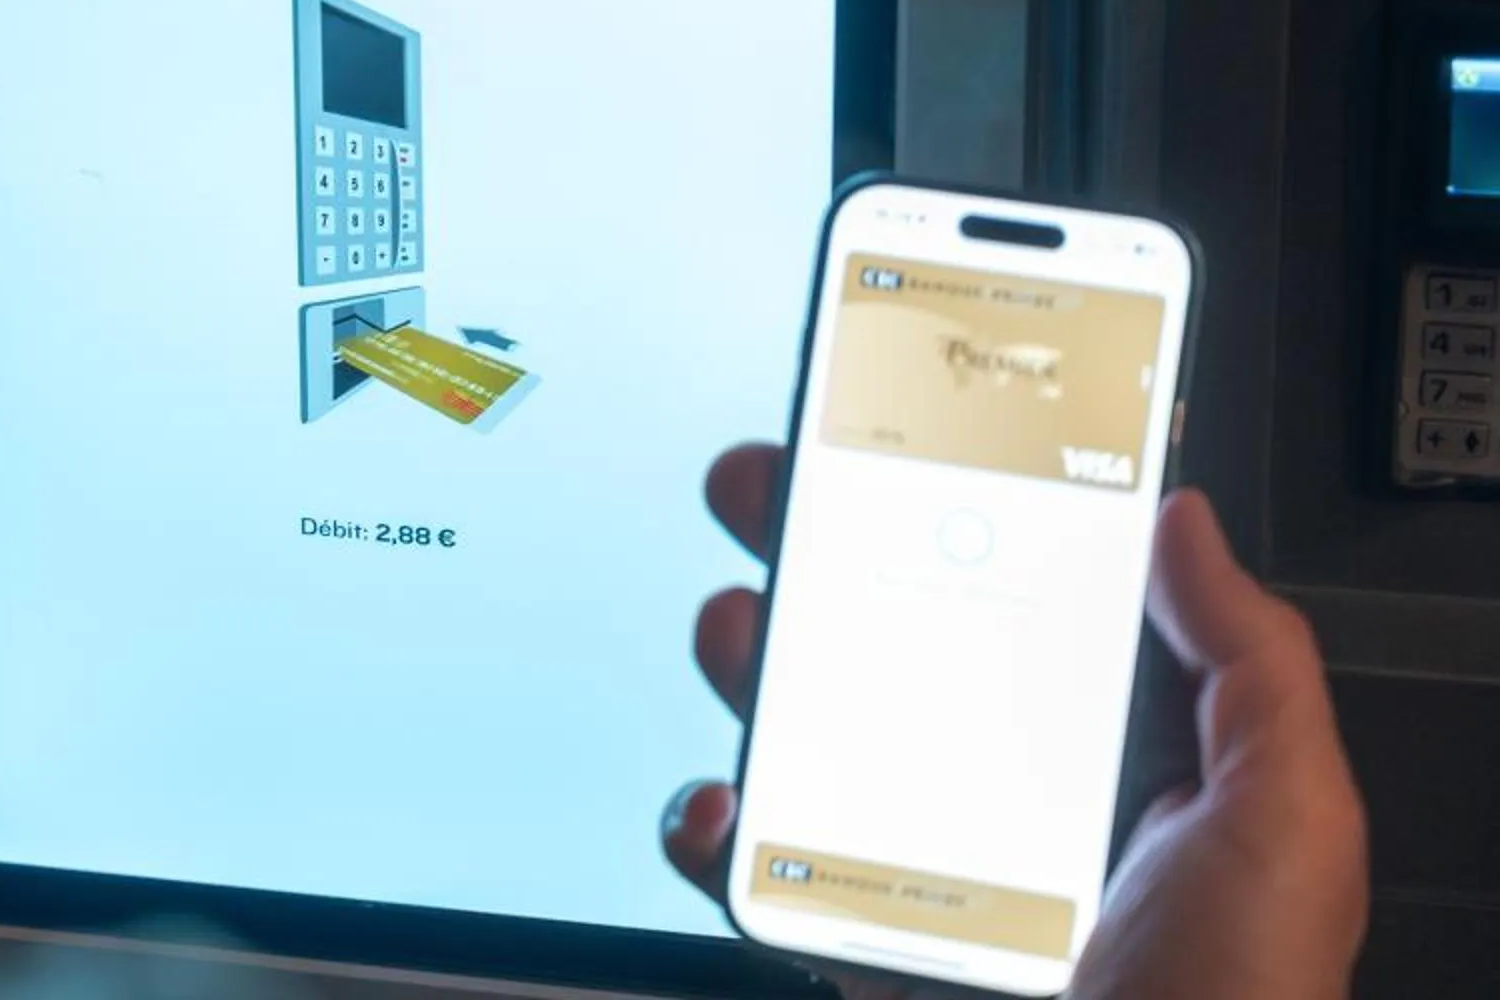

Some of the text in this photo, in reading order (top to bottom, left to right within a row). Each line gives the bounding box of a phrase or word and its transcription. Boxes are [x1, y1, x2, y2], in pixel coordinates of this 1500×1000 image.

[319, 135, 327, 149] 1
[349, 141, 357, 155] 2
[377, 145, 384, 159] 3
[319, 174, 385, 193] 4 5 6
[321, 213, 385, 228] 7 8 9
[1434, 283, 1452, 306] 1
[1430, 331, 1450, 355] 4
[1430, 379, 1448, 403] 7
[1060, 445, 1134, 484] VISA
[301, 517, 456, 547] Débit: 2,88 €
